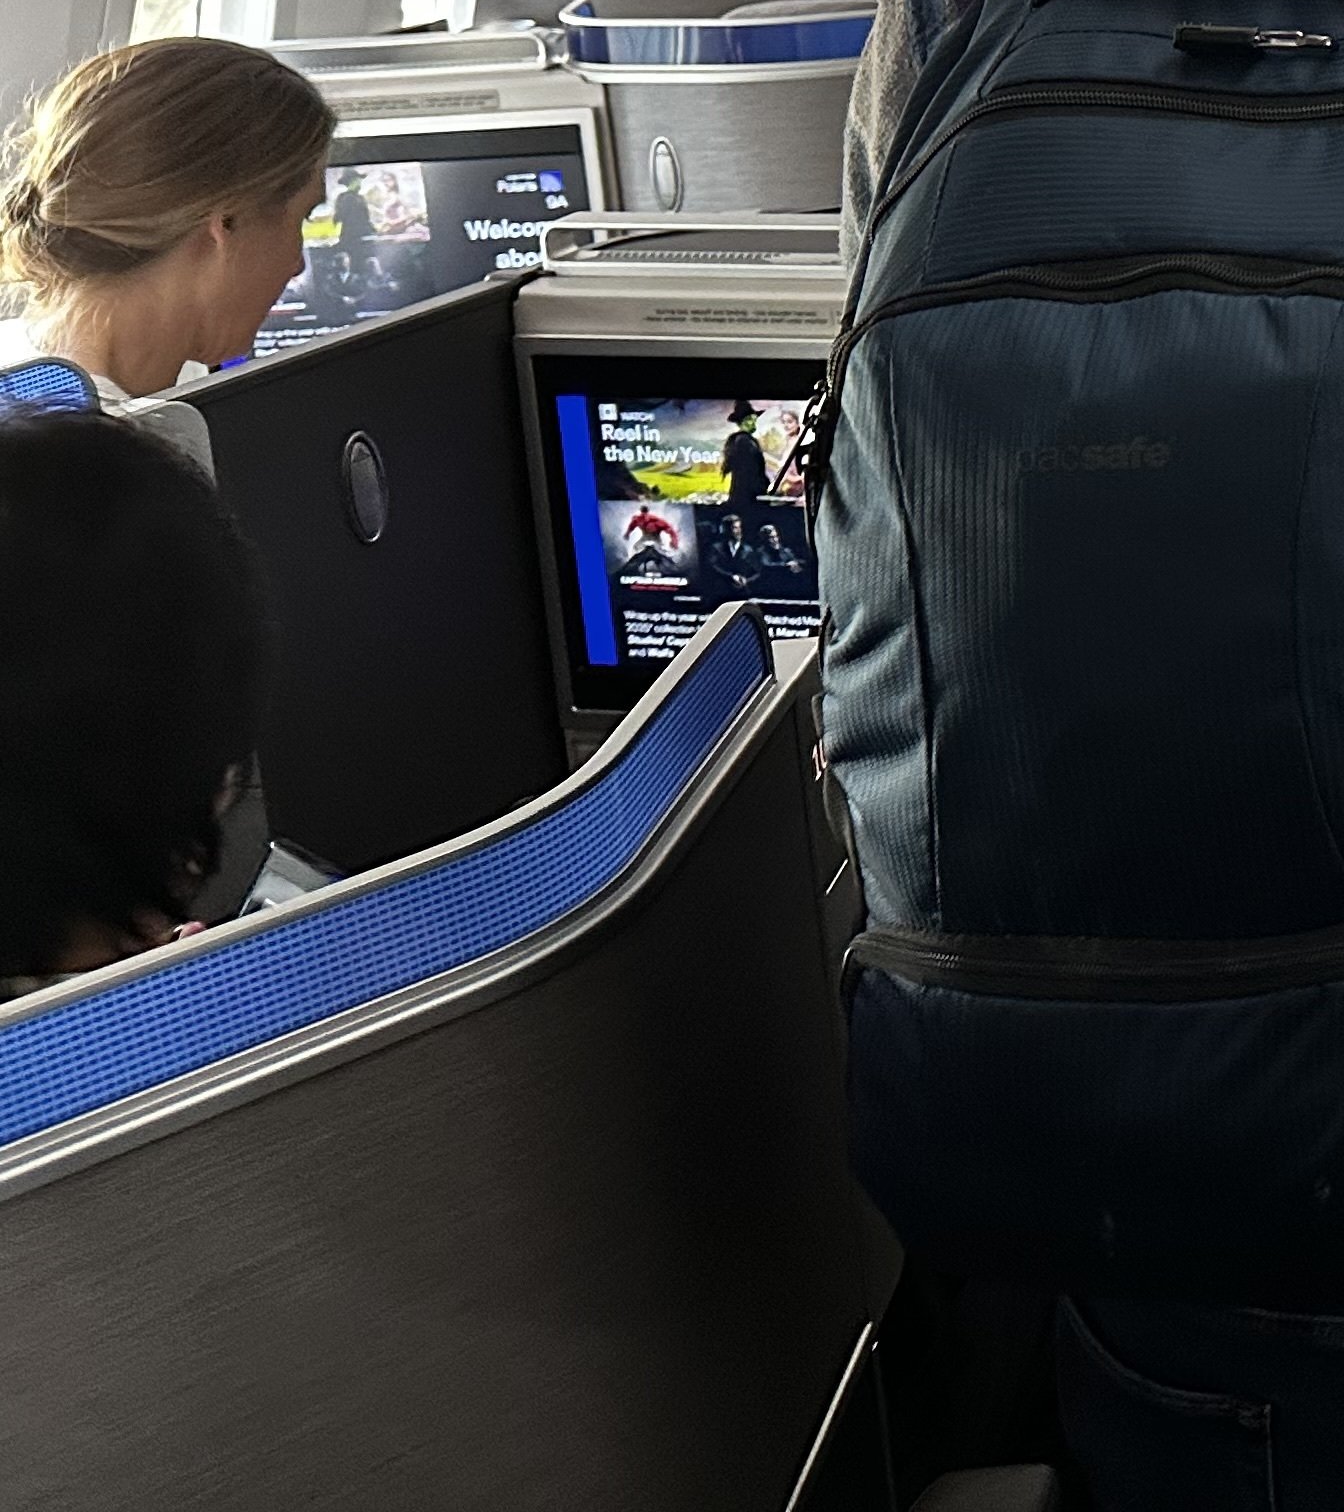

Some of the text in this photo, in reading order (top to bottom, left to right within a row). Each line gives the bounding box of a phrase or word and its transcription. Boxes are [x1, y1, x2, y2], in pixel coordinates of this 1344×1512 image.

[601, 423, 661, 442] Reel in
[603, 444, 722, 464] the New Year
